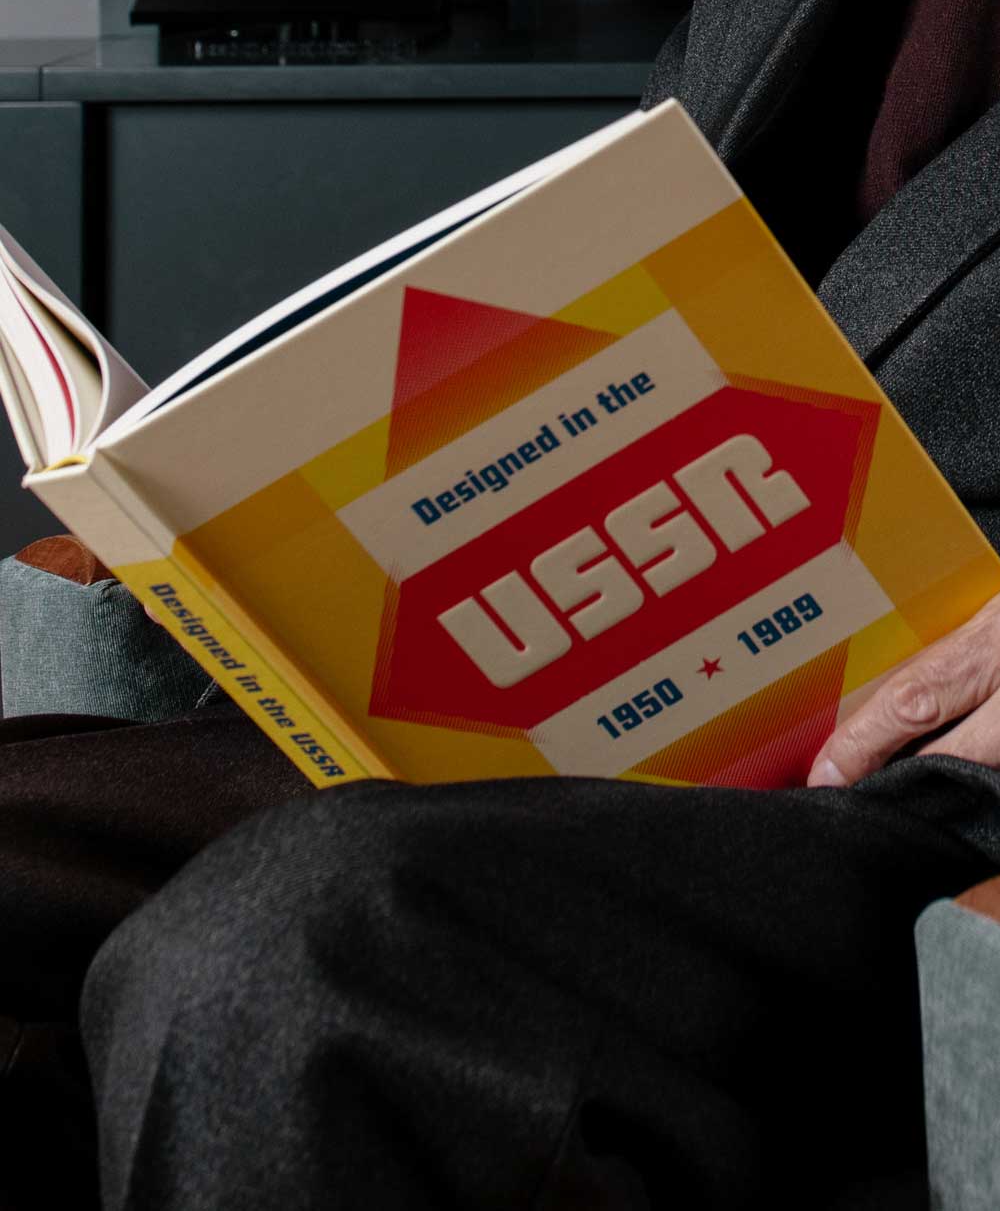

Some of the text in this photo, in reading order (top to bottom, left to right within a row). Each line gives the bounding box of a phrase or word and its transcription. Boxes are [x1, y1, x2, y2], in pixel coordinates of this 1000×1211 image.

[411, 372, 655, 526] Designed in the
[436, 433, 812, 689] USSR
[150, 583, 345, 777] Designed in the USSR
[596, 592, 823, 740] 1950 1989
